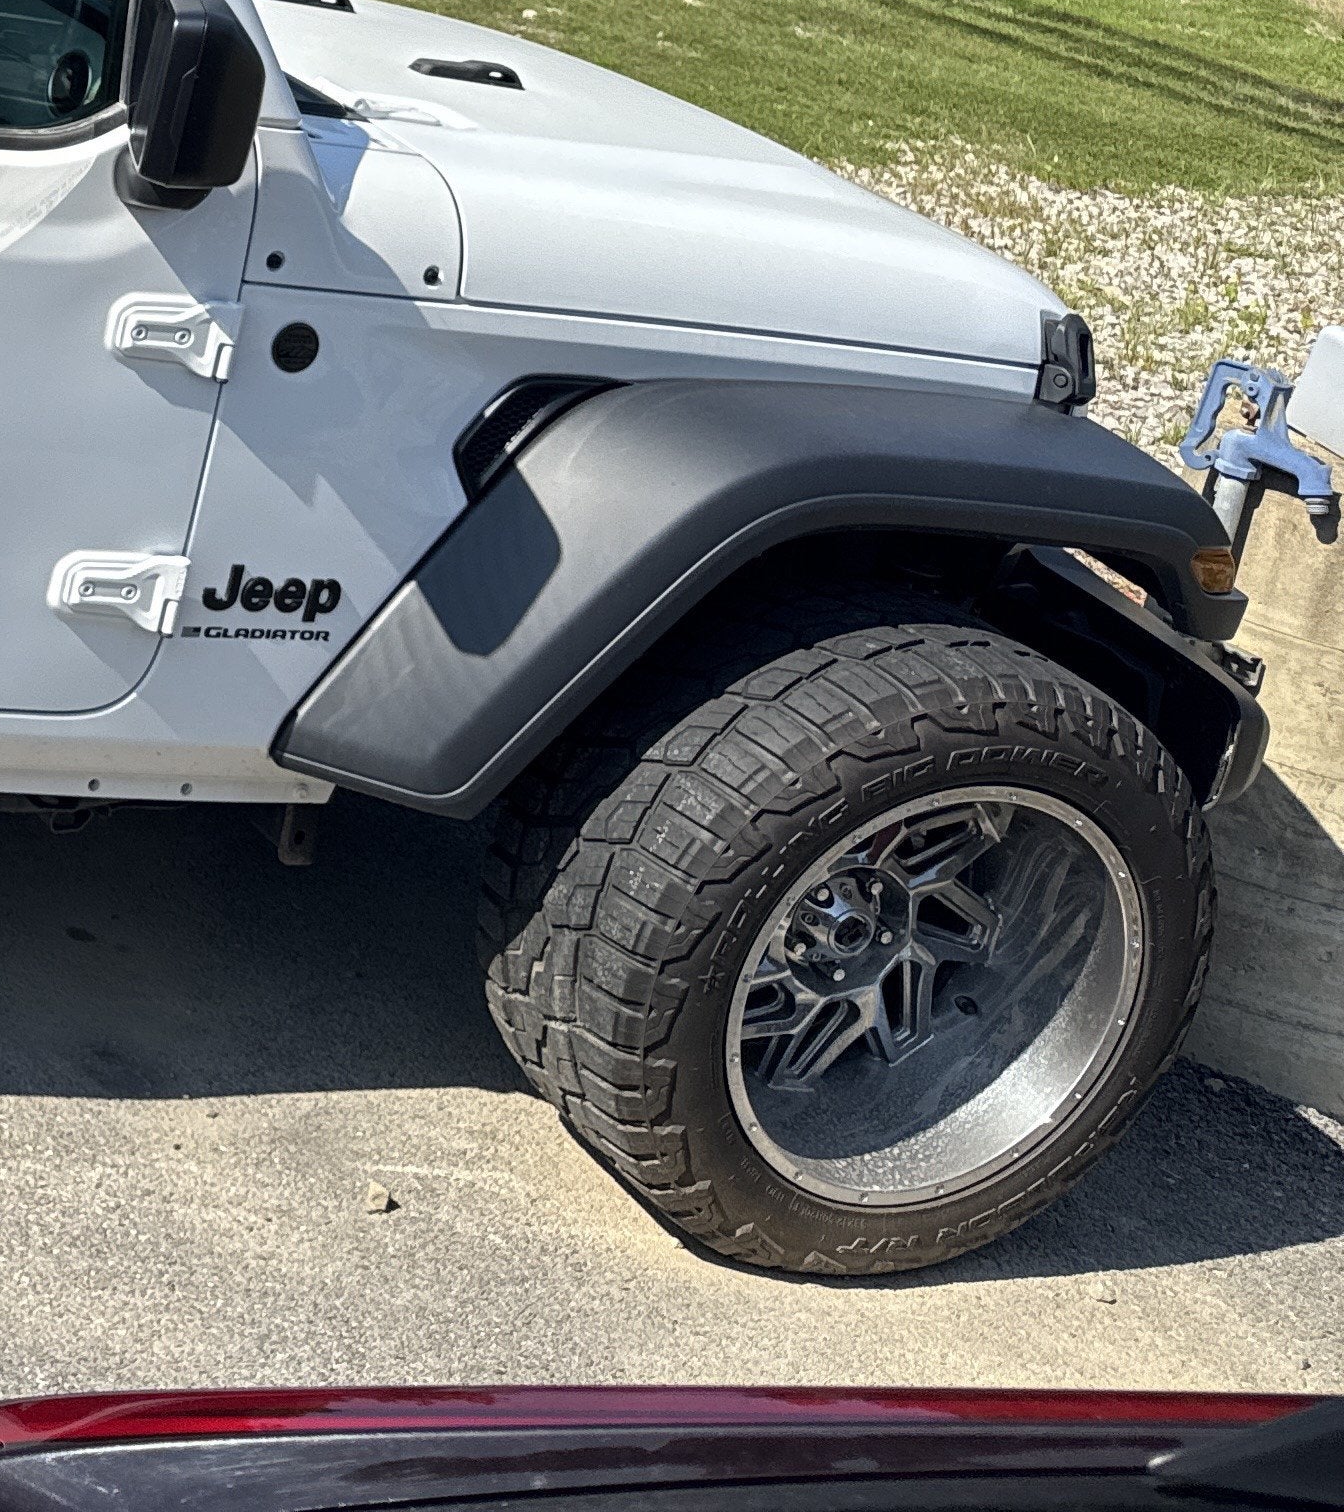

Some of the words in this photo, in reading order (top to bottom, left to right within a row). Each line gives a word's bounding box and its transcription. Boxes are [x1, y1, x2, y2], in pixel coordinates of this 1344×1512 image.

[202, 564, 342, 623] Jeep
[203, 626, 330, 642] GLADIATOR
[861, 754, 937, 801] BIG
[945, 744, 1111, 787] POWER
